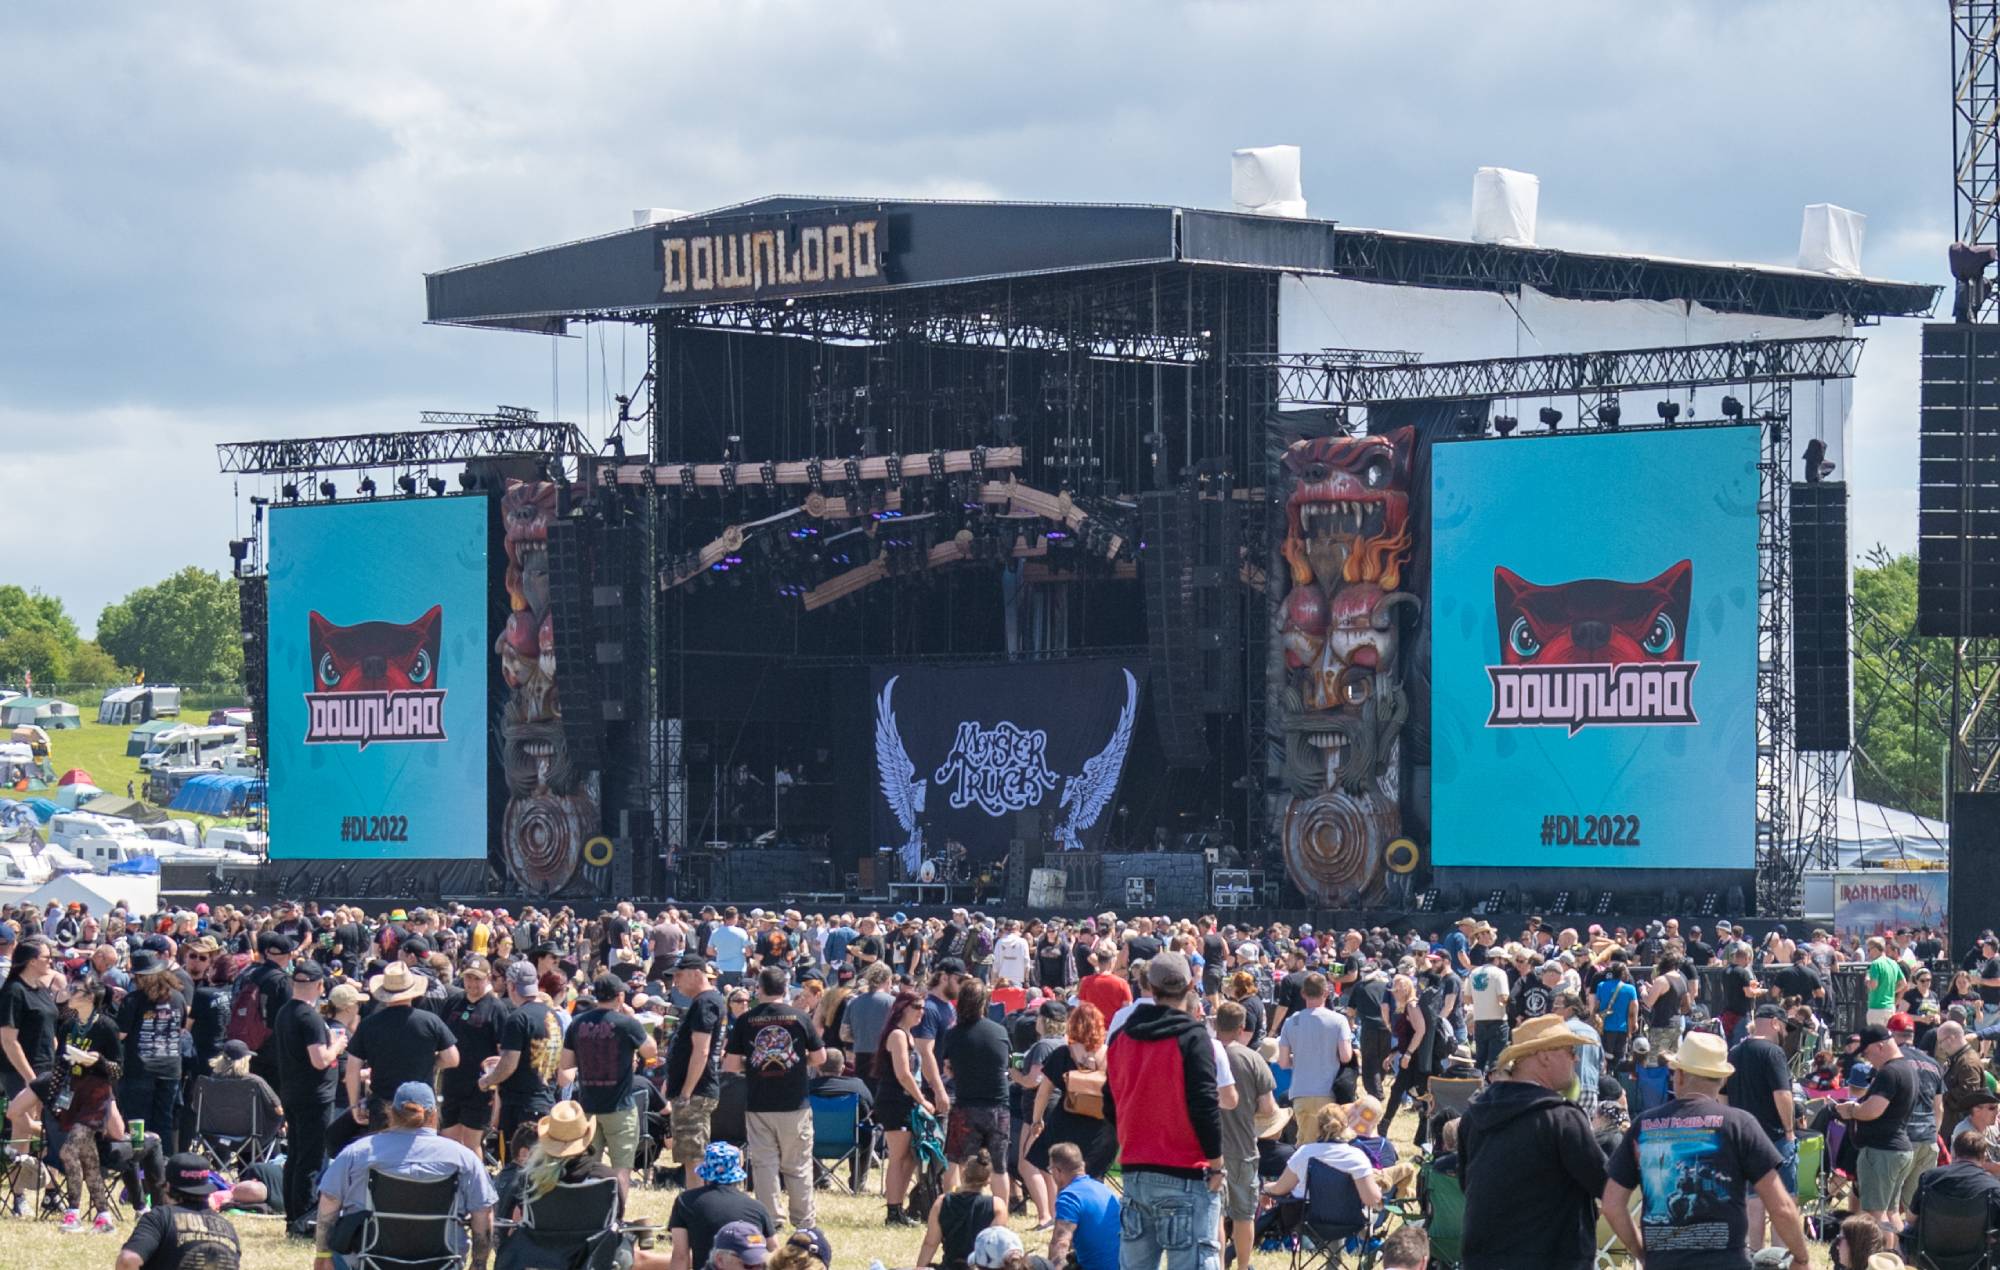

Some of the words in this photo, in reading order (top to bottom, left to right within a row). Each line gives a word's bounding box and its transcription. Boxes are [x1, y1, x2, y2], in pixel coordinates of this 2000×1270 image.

[662, 221, 878, 293] DOWNLOAD
[1496, 671, 1688, 722] DOWNLOAD
[311, 697, 441, 738] DOWNLOAD
[936, 750, 1043, 816] TRUCK
[341, 815, 408, 842] #DL2022
[1541, 814, 1641, 847] #DL2022
[1840, 884, 1869, 903] IRON
[1870, 883, 1918, 902] MAIDEN
